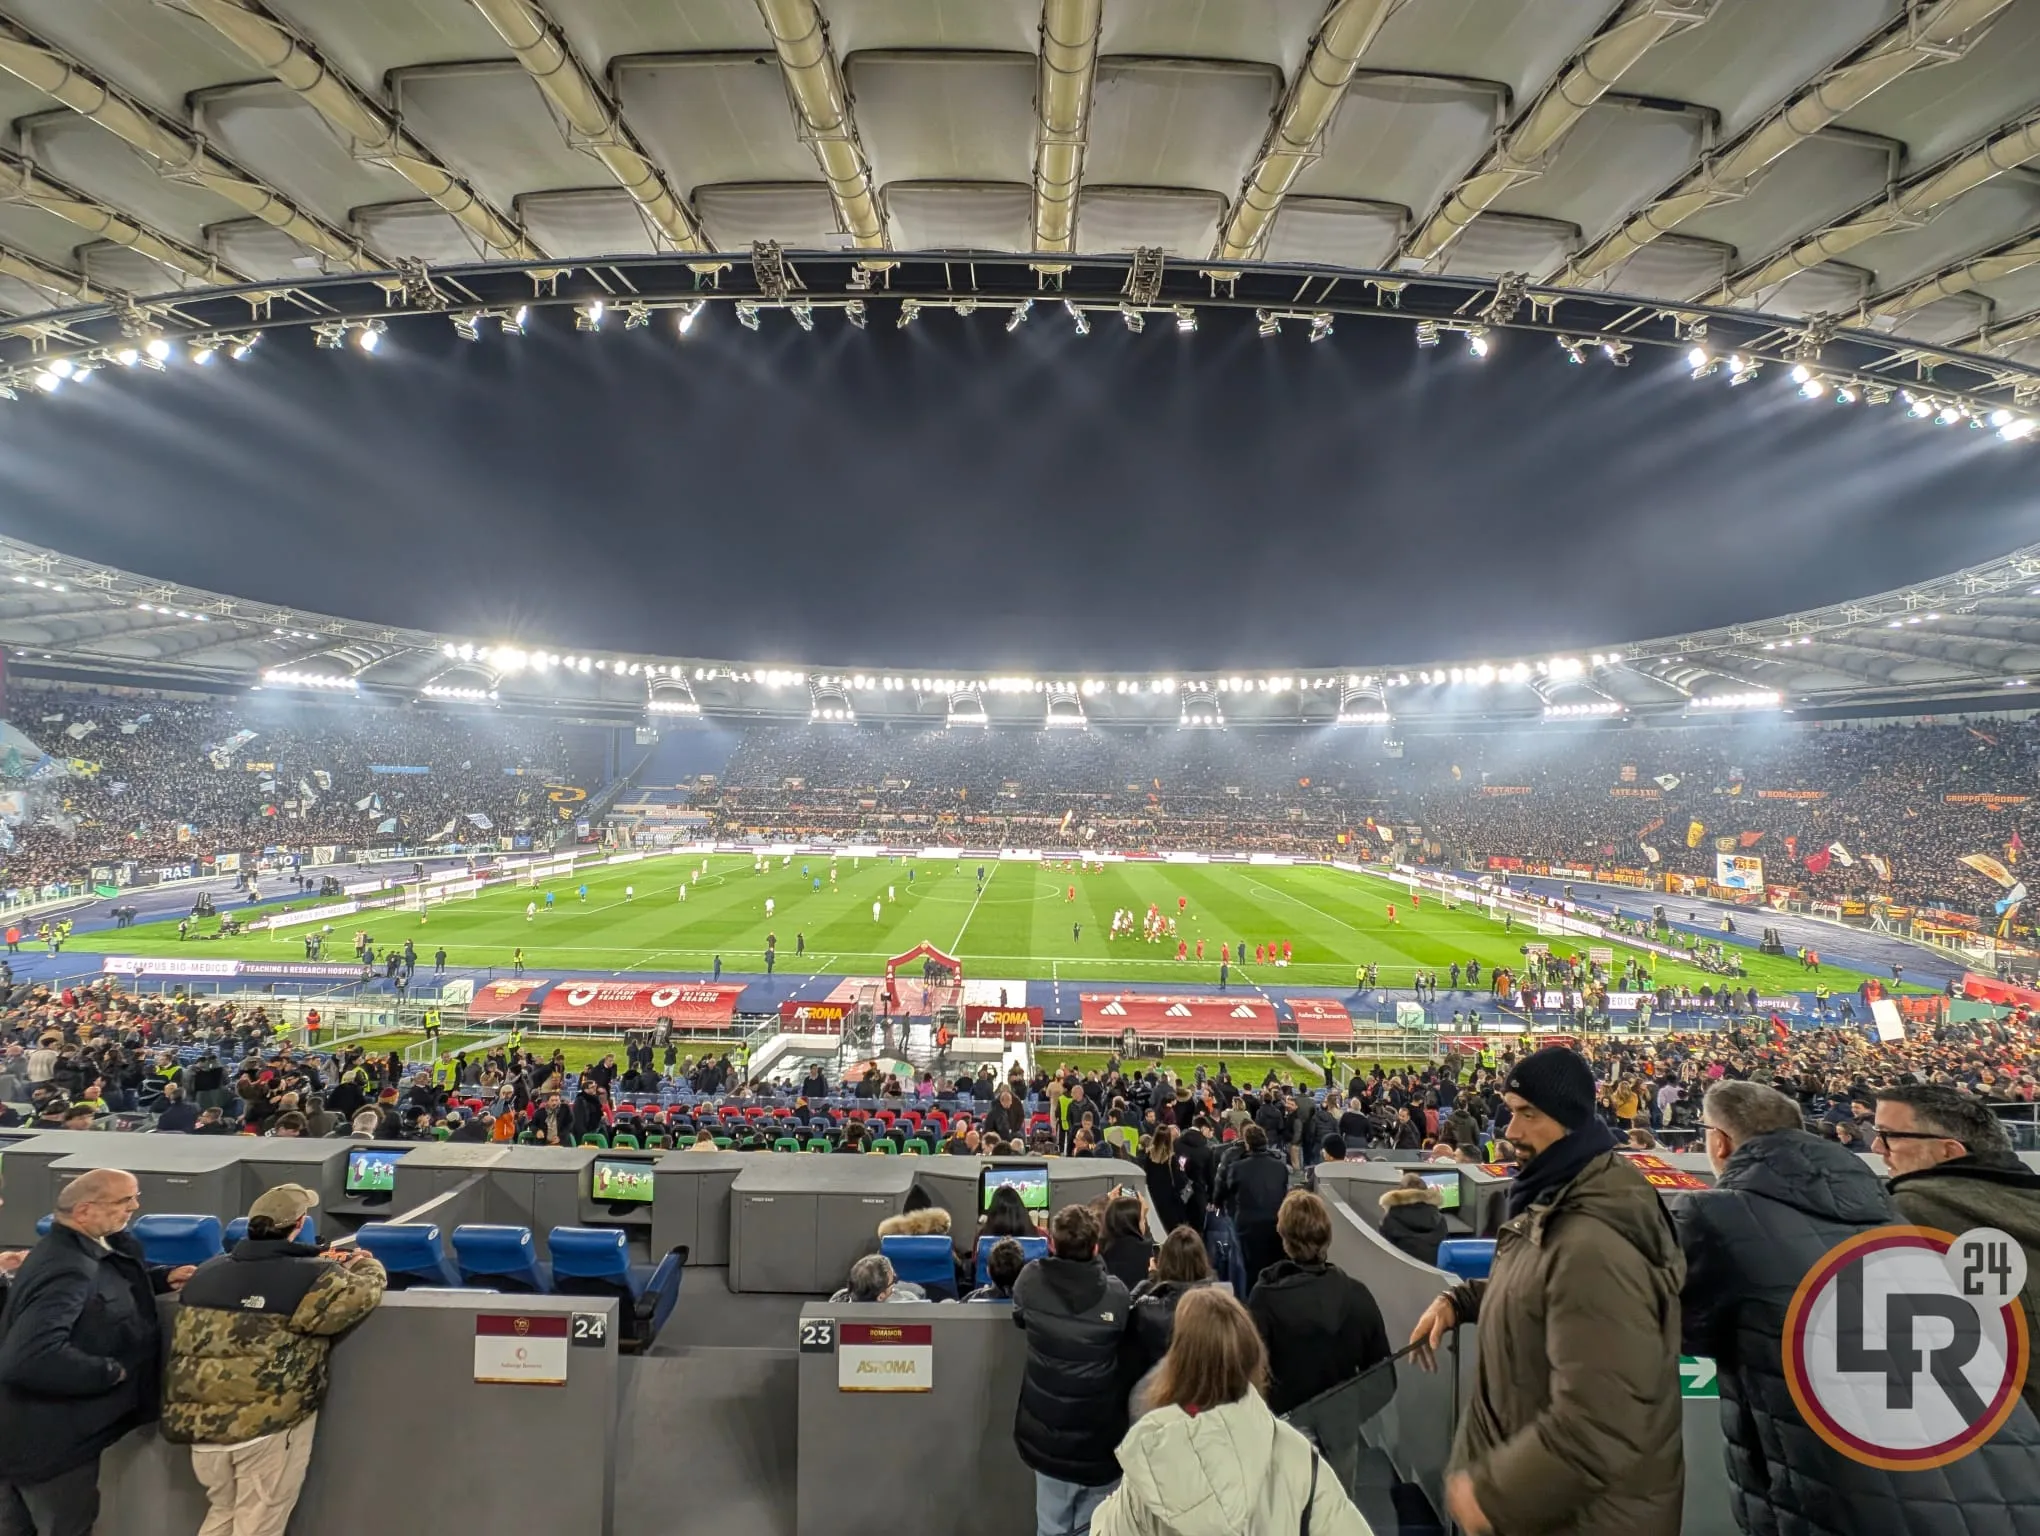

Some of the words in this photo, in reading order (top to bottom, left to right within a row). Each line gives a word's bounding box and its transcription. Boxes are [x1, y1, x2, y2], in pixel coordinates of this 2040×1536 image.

[126, 961, 167, 971] CAMPUS
[170, 962, 229, 973] BIO-MEDICO
[246, 965, 282, 974] TEACHING
[289, 966, 326, 975] RESEARCH
[327, 967, 363, 976] HOSPITAL
[1757, 999, 1790, 1009] OSPITAL
[574, 1320, 604, 1339] 24
[802, 1326, 831, 1345] 23
